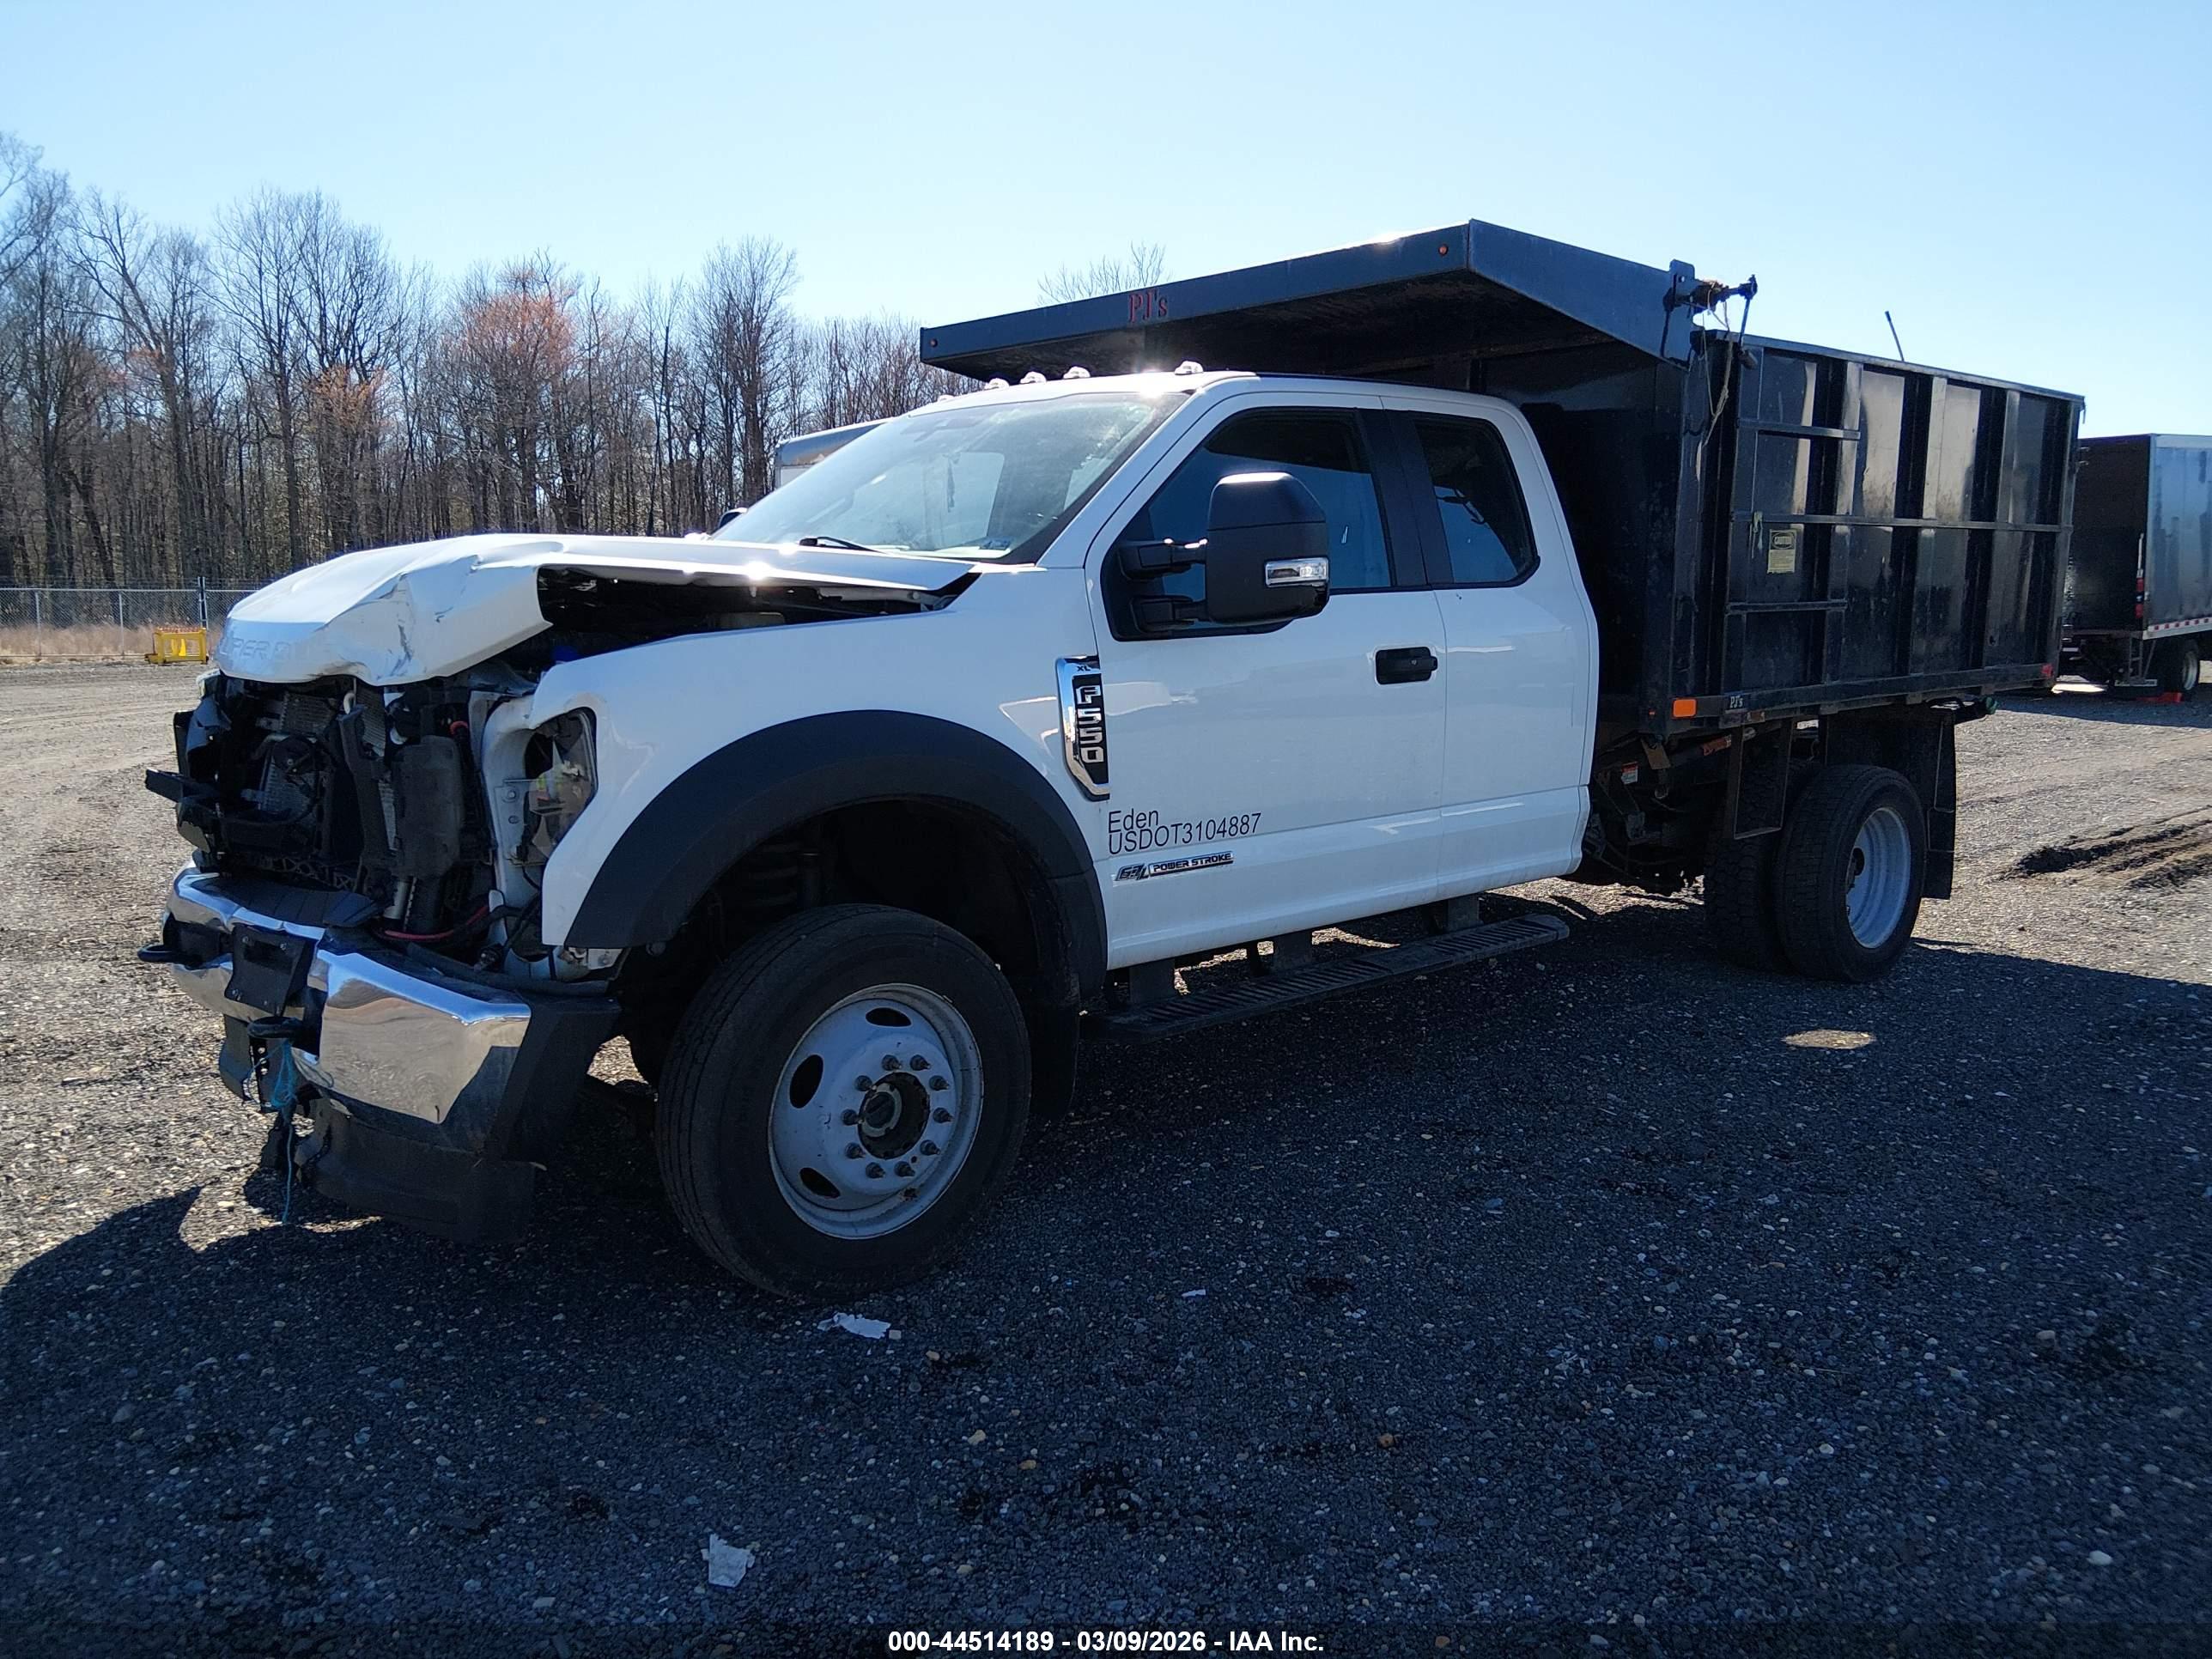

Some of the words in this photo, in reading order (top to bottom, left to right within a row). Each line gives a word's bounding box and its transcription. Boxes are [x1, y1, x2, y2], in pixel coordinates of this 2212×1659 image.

[1108, 808, 1159, 834] Eden
[1109, 812, 1261, 855] USDOT3104887
[1152, 860, 1189, 872] POWER
[1191, 853, 1231, 866] STROKE
